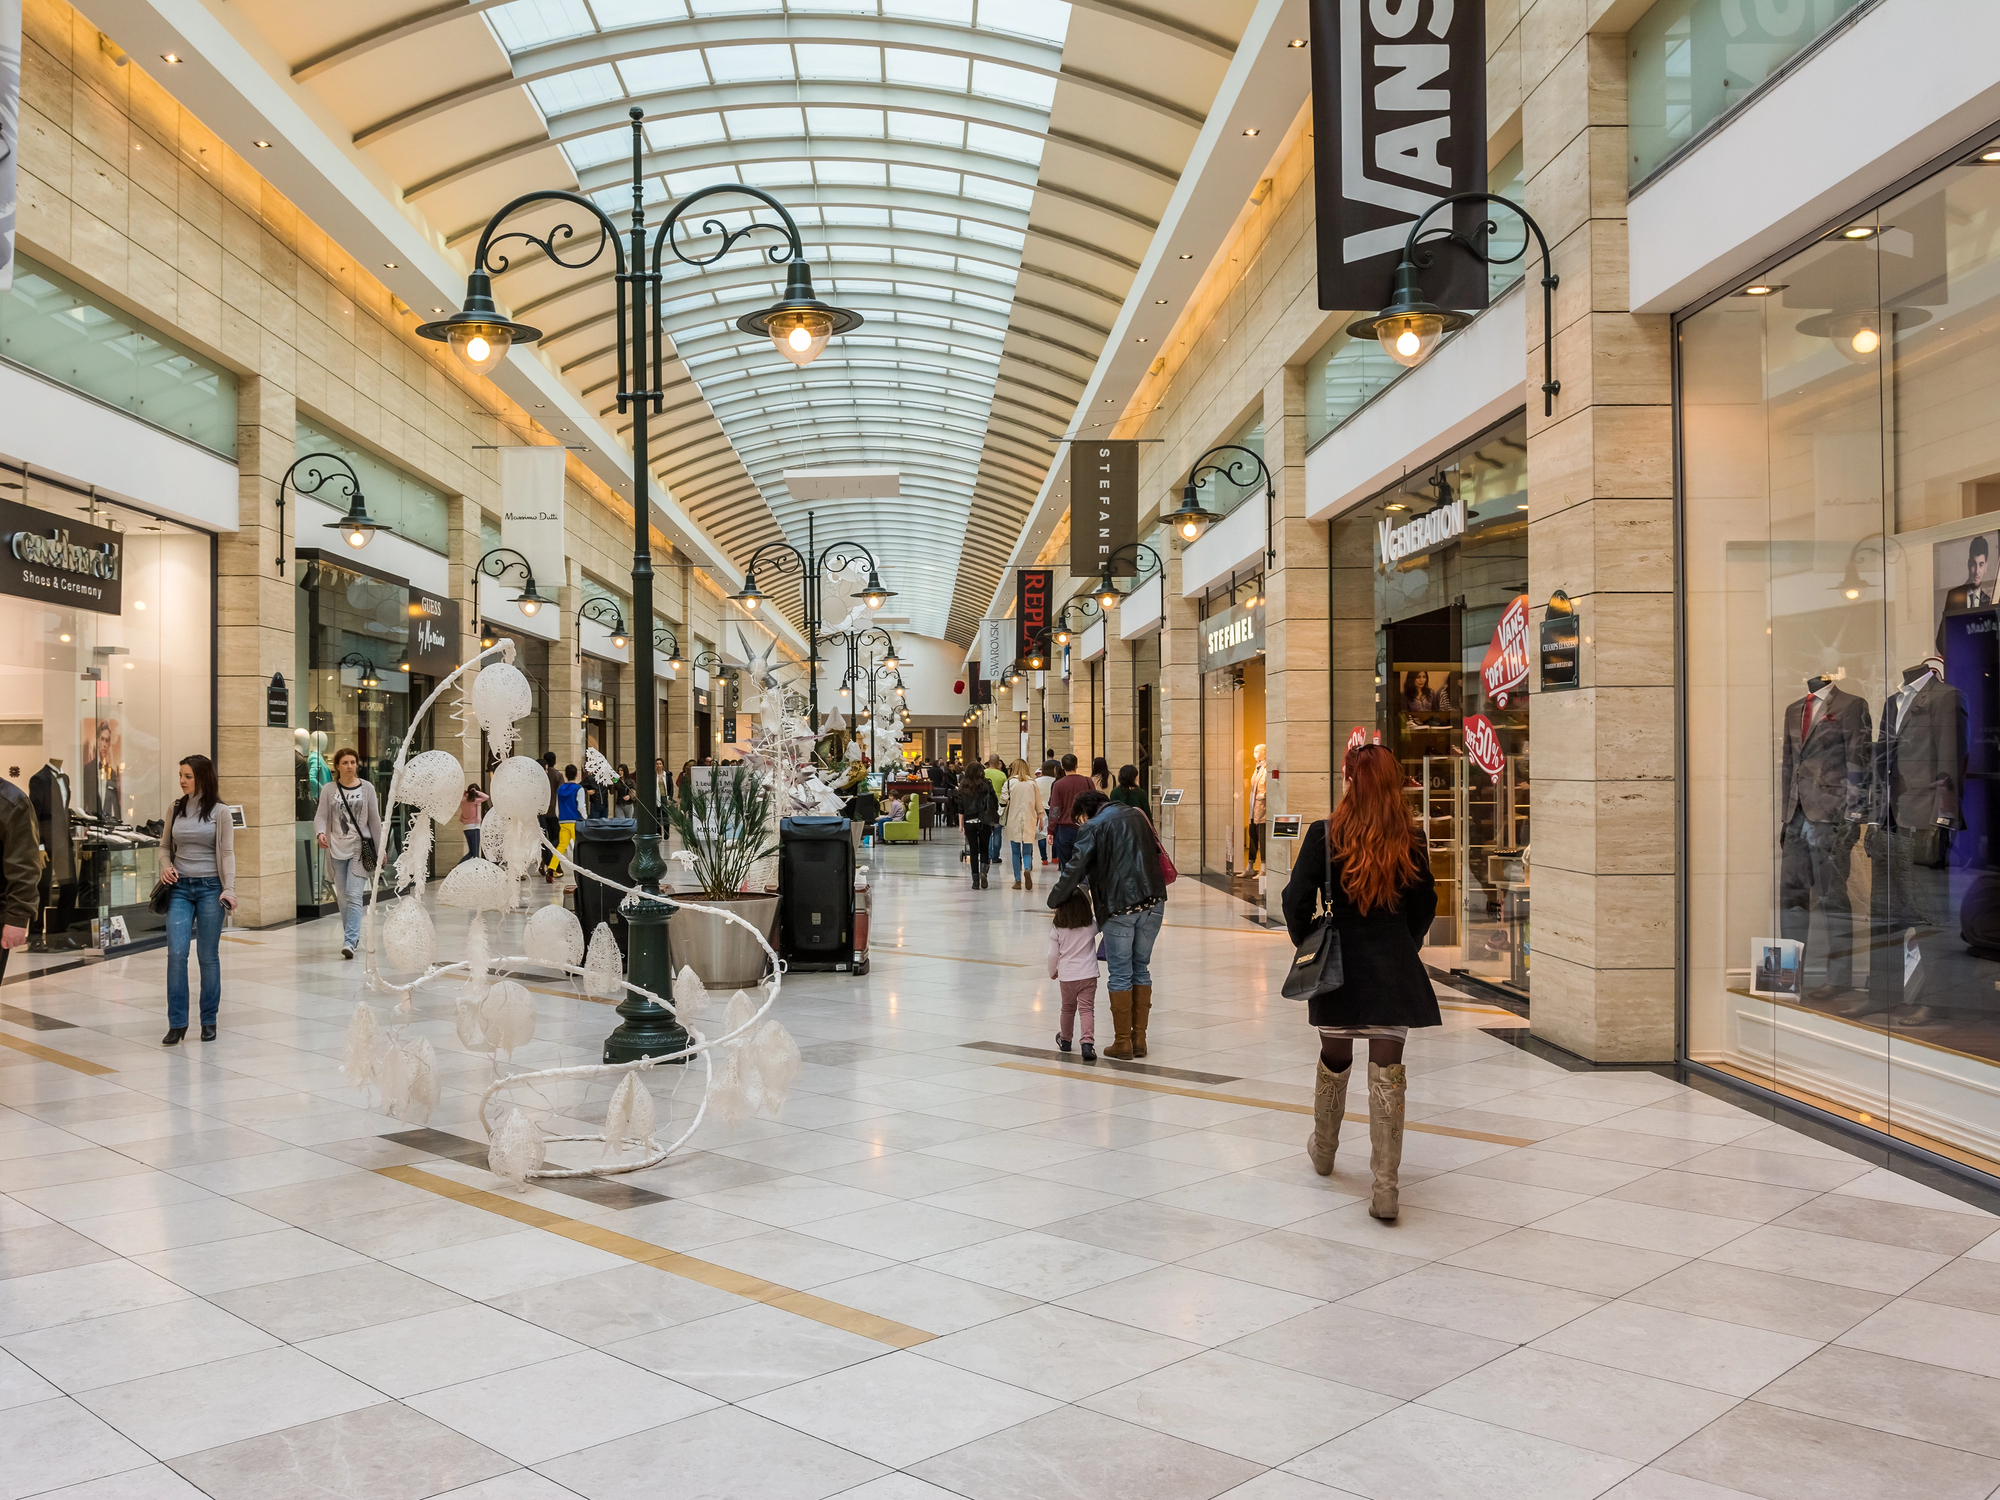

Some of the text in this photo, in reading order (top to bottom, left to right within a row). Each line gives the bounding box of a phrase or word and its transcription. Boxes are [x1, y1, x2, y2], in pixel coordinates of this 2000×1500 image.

[505, 511, 559, 521] Massimo Dutti
[1099, 448, 1110, 570] STEFANEL
[22, 569, 102, 600] Shoes & Ceremony
[421, 596, 442, 617] GUESS
[1023, 573, 1045, 667] REPLA
[1208, 615, 1254, 655] STEFANEL
[1497, 598, 1525, 651] VANS
[990, 620, 999, 677] SWAROVSKI
[1503, 632, 1525, 681] THE
